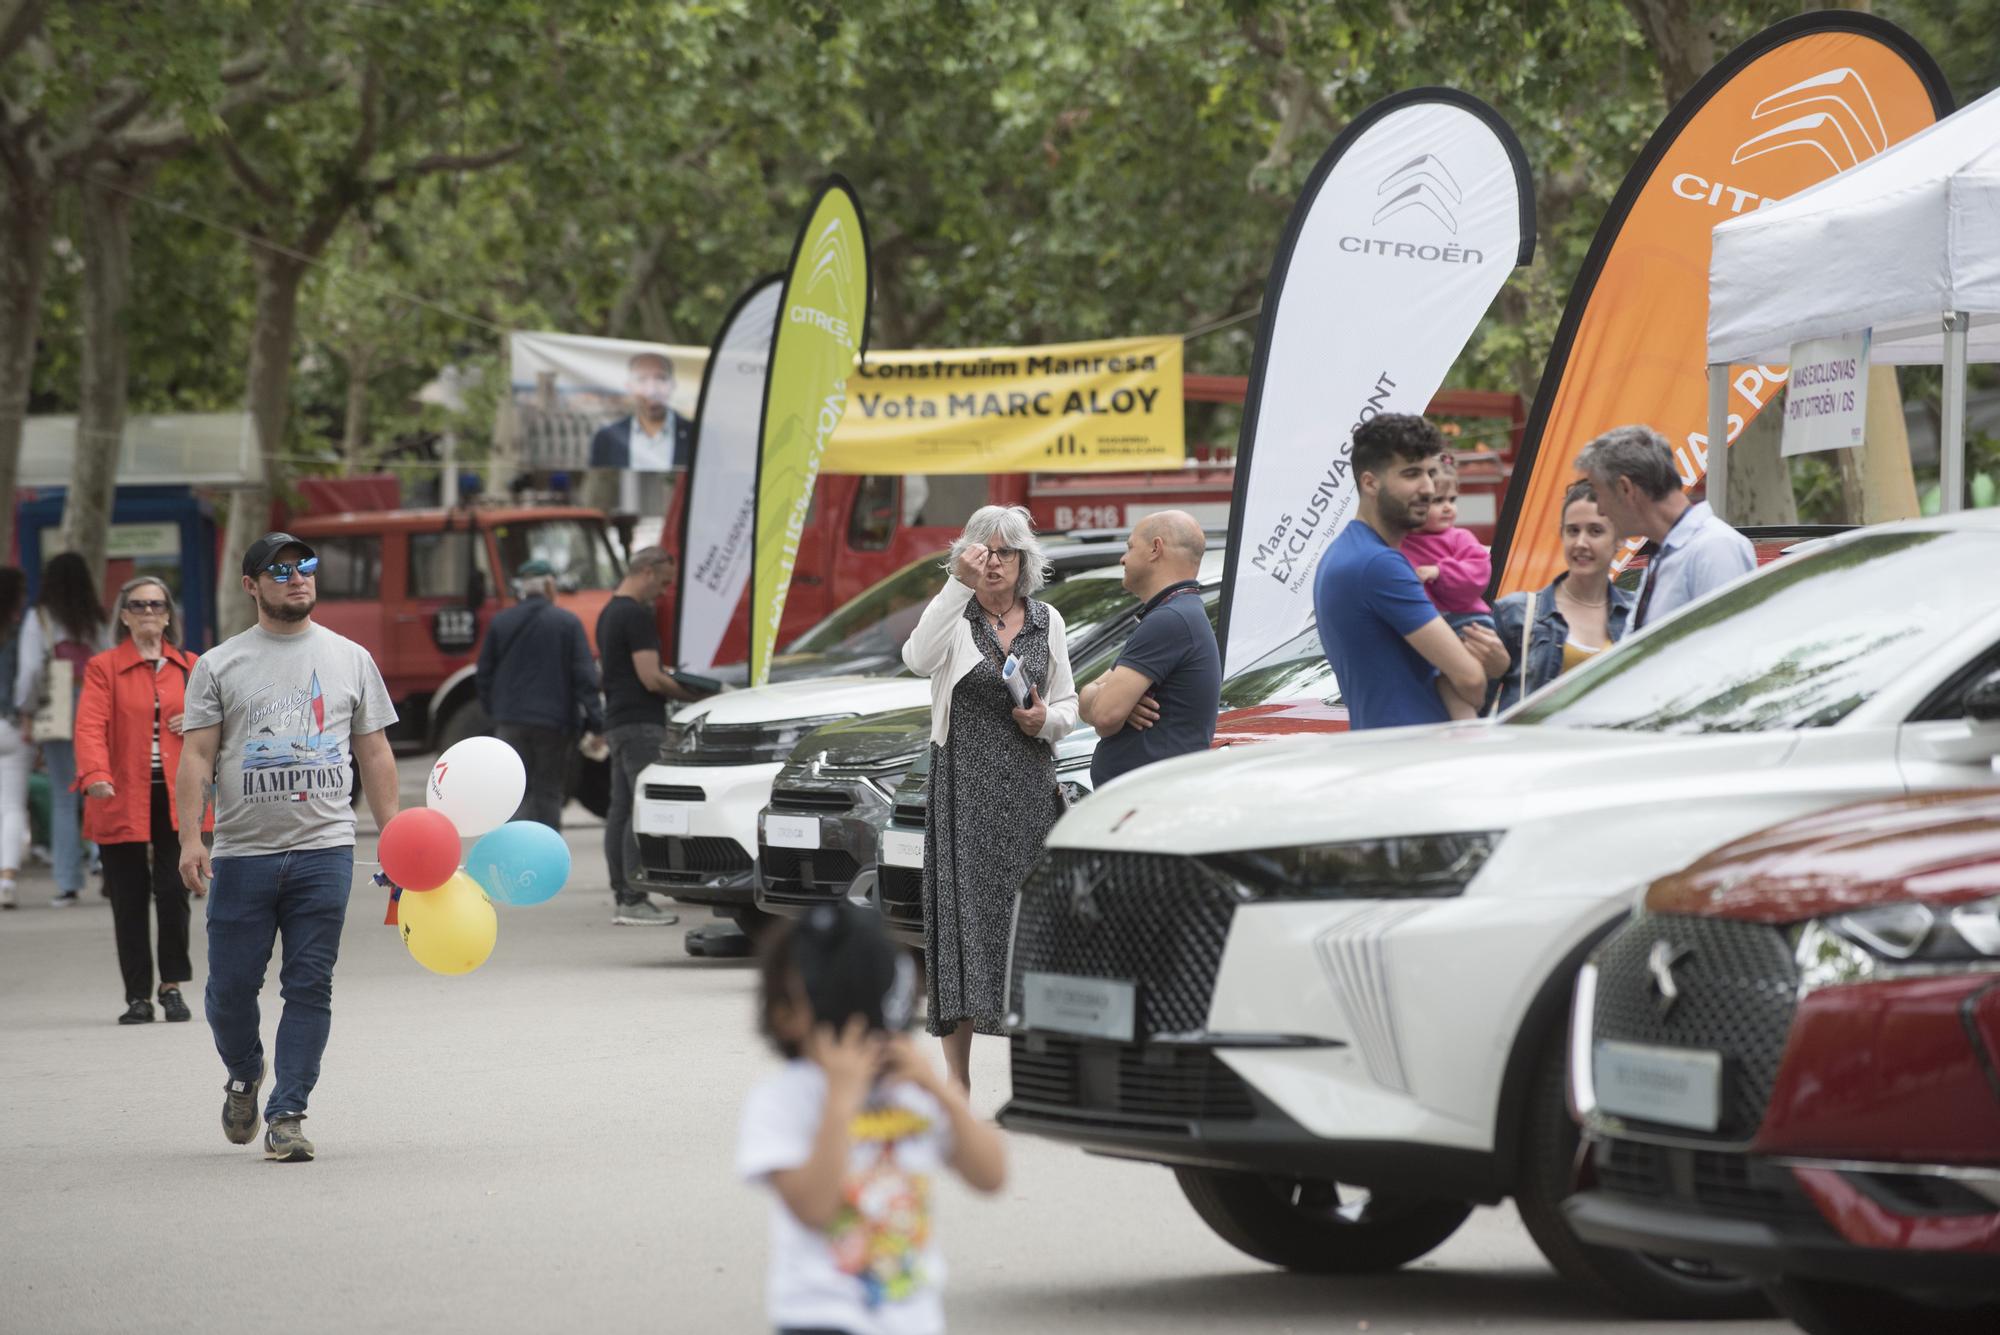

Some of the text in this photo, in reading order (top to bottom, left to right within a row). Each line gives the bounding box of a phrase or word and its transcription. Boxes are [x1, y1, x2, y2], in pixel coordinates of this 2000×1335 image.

[1028, 353, 1157, 377] Manresa
[1809, 358, 1856, 385] EXCLUSIVAS
[858, 387, 1160, 420] Vota MARC ALOY
[1842, 390, 1855, 412] DS
[1271, 441, 1354, 584] EXCLUSIVAS
[1251, 512, 1293, 571] Maas
[1290, 551, 1320, 594] Manresa
[440, 611, 474, 635] 112
[243, 765, 344, 795] HAMPTONS
[244, 794, 288, 804] SAILING
